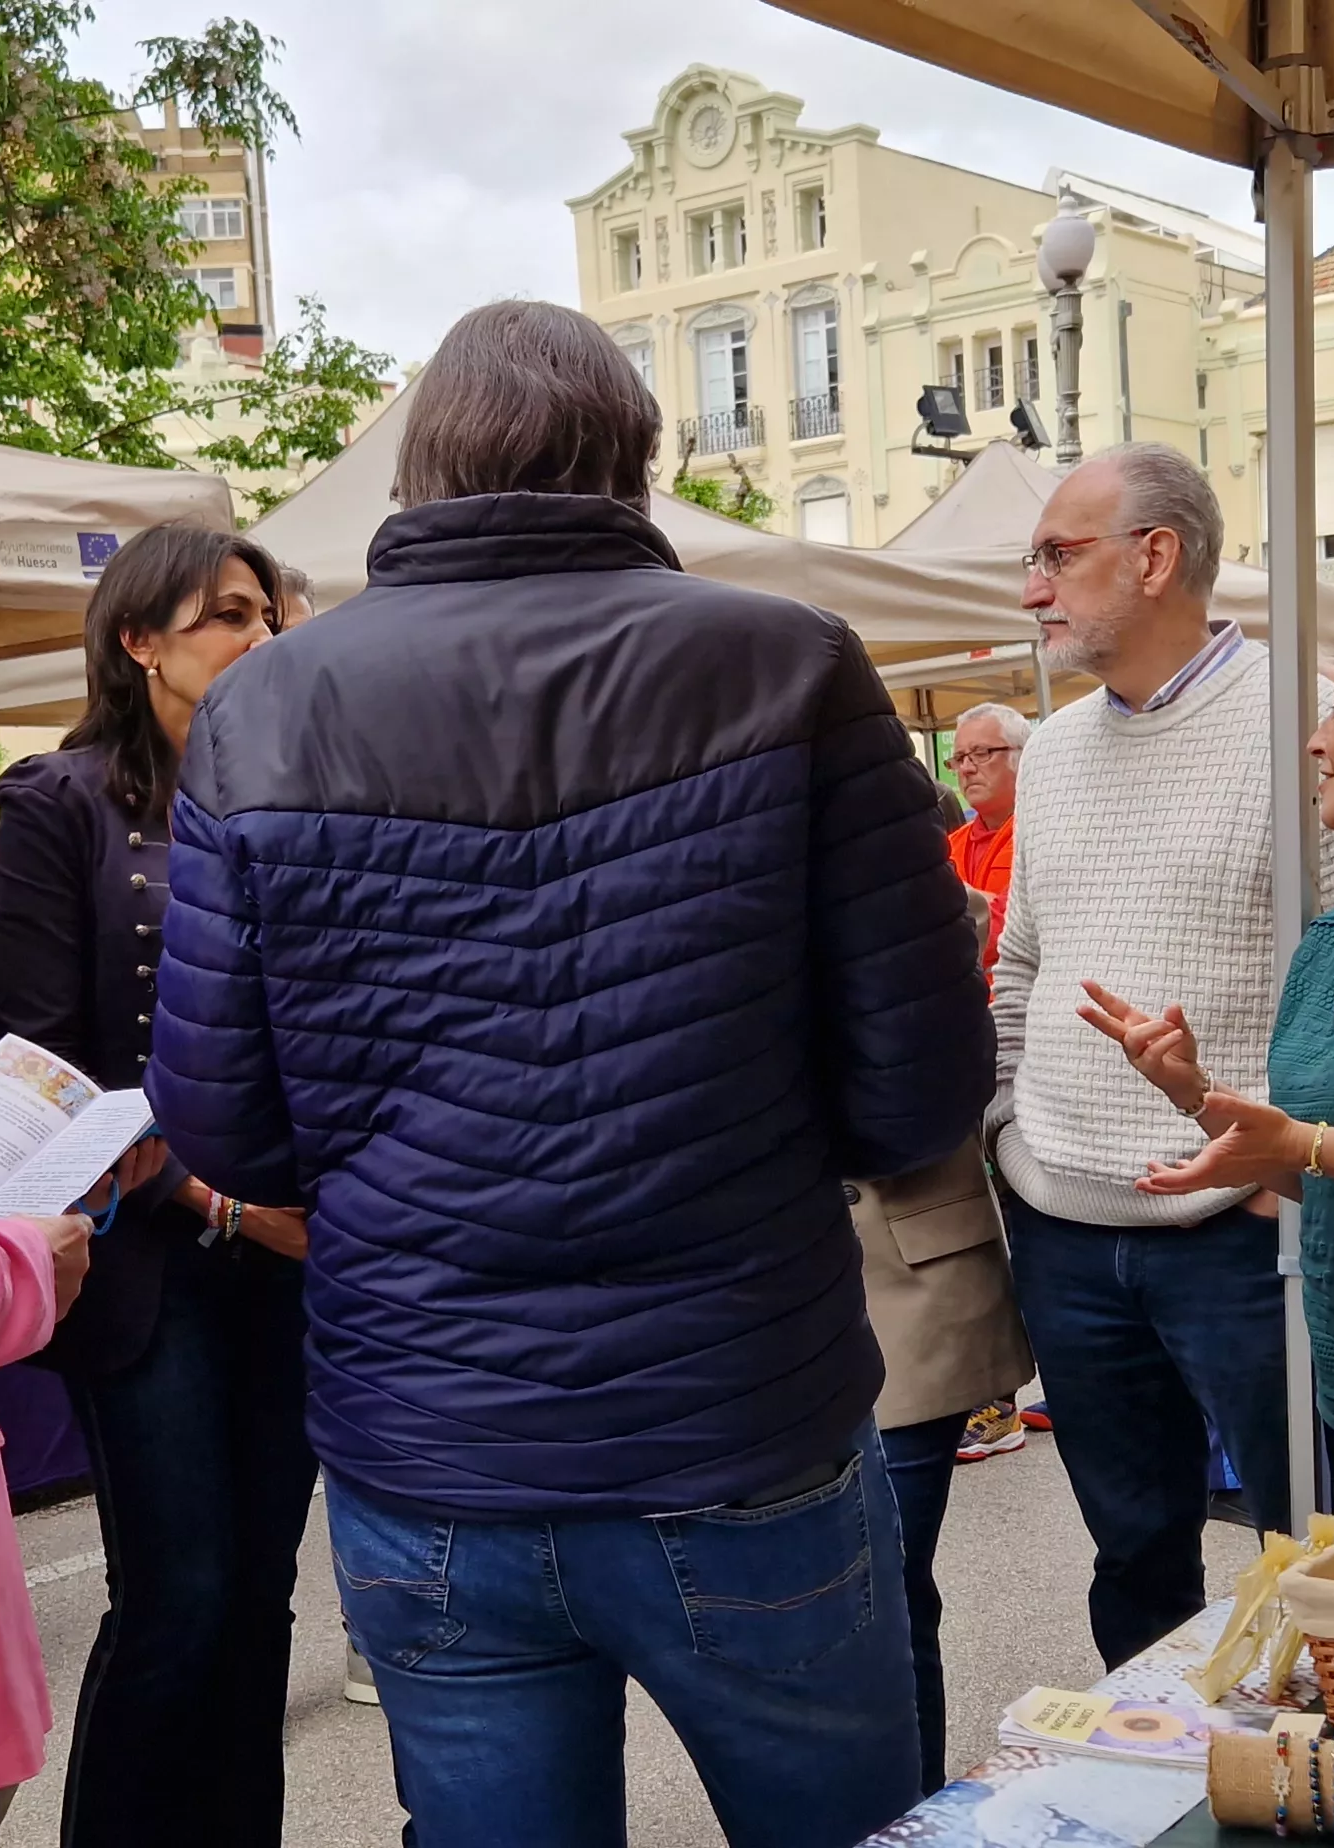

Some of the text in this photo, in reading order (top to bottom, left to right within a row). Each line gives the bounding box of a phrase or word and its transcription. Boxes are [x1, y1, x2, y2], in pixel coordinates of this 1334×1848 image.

[0, 540, 73, 556] Ayuntamiento
[1, 555, 57, 569] de Huesca
